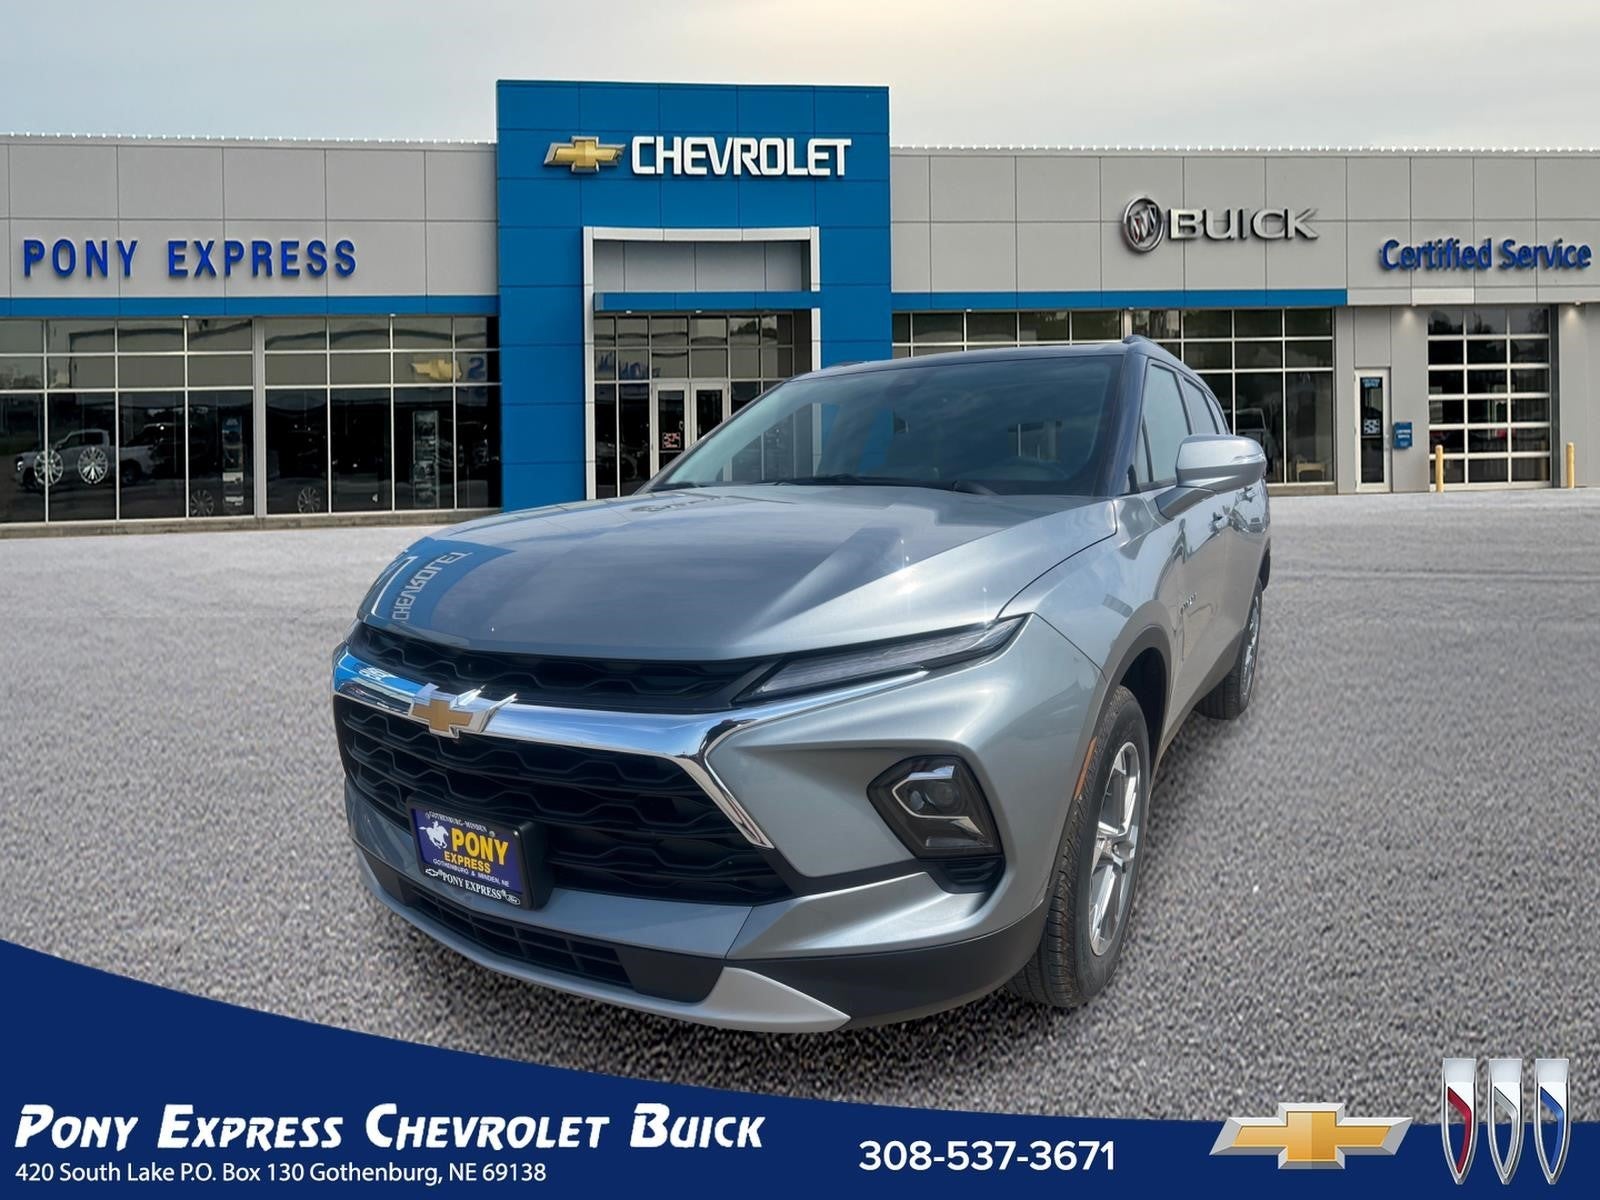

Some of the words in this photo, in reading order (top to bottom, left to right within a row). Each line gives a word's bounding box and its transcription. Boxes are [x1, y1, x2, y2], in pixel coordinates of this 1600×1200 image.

[631, 136, 852, 177] CHEVROLET
[1168, 207, 1319, 241] BUICK
[22, 239, 137, 279] PONY
[167, 239, 357, 278] EXPRESS
[1379, 239, 1493, 271] Certified
[1500, 239, 1592, 270] Service
[443, 850, 492, 874] EXPRESS
[451, 827, 509, 866] PONY
[442, 871, 464, 888] PONY
[464, 879, 503, 900] EXPRESS
